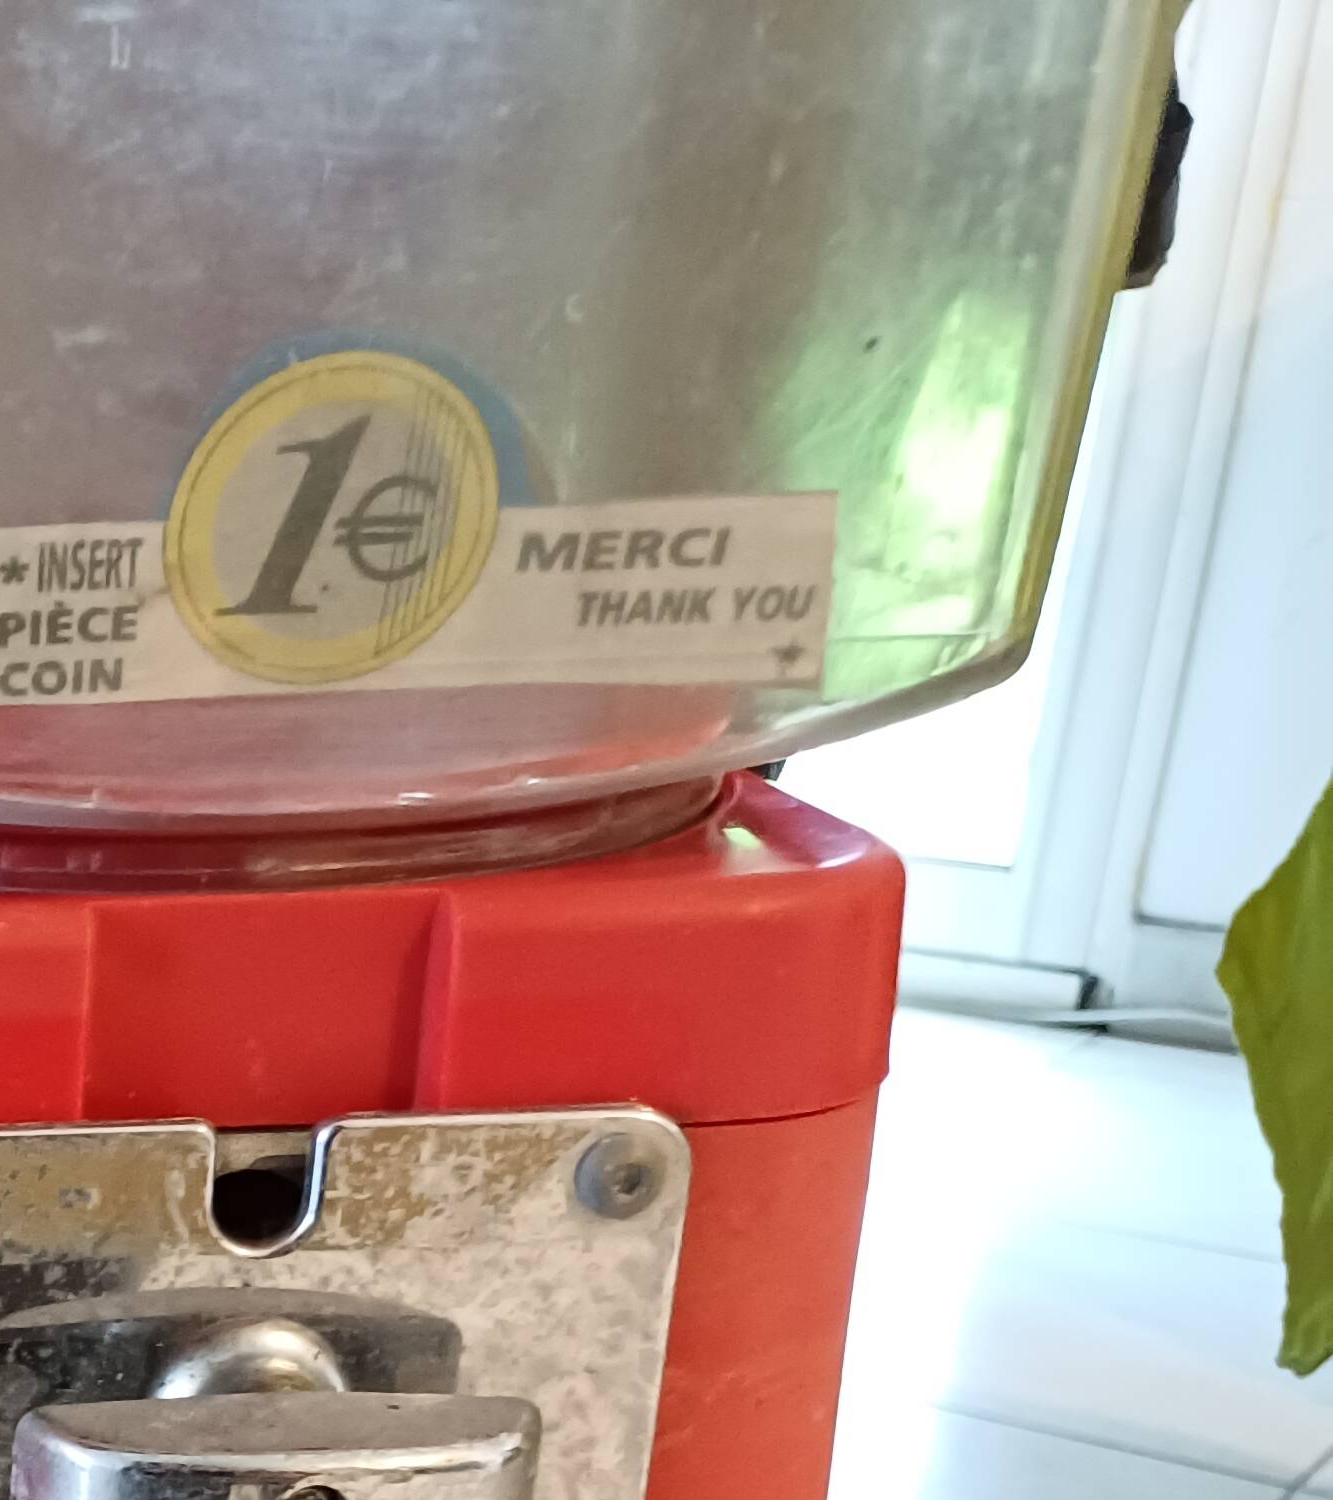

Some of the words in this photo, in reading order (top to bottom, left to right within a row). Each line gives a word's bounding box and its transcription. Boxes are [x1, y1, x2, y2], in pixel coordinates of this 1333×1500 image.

[36, 537, 142, 590] INSERT
[516, 526, 729, 574] MERCI
[577, 588, 714, 628] THANK
[731, 585, 815, 622] YOU
